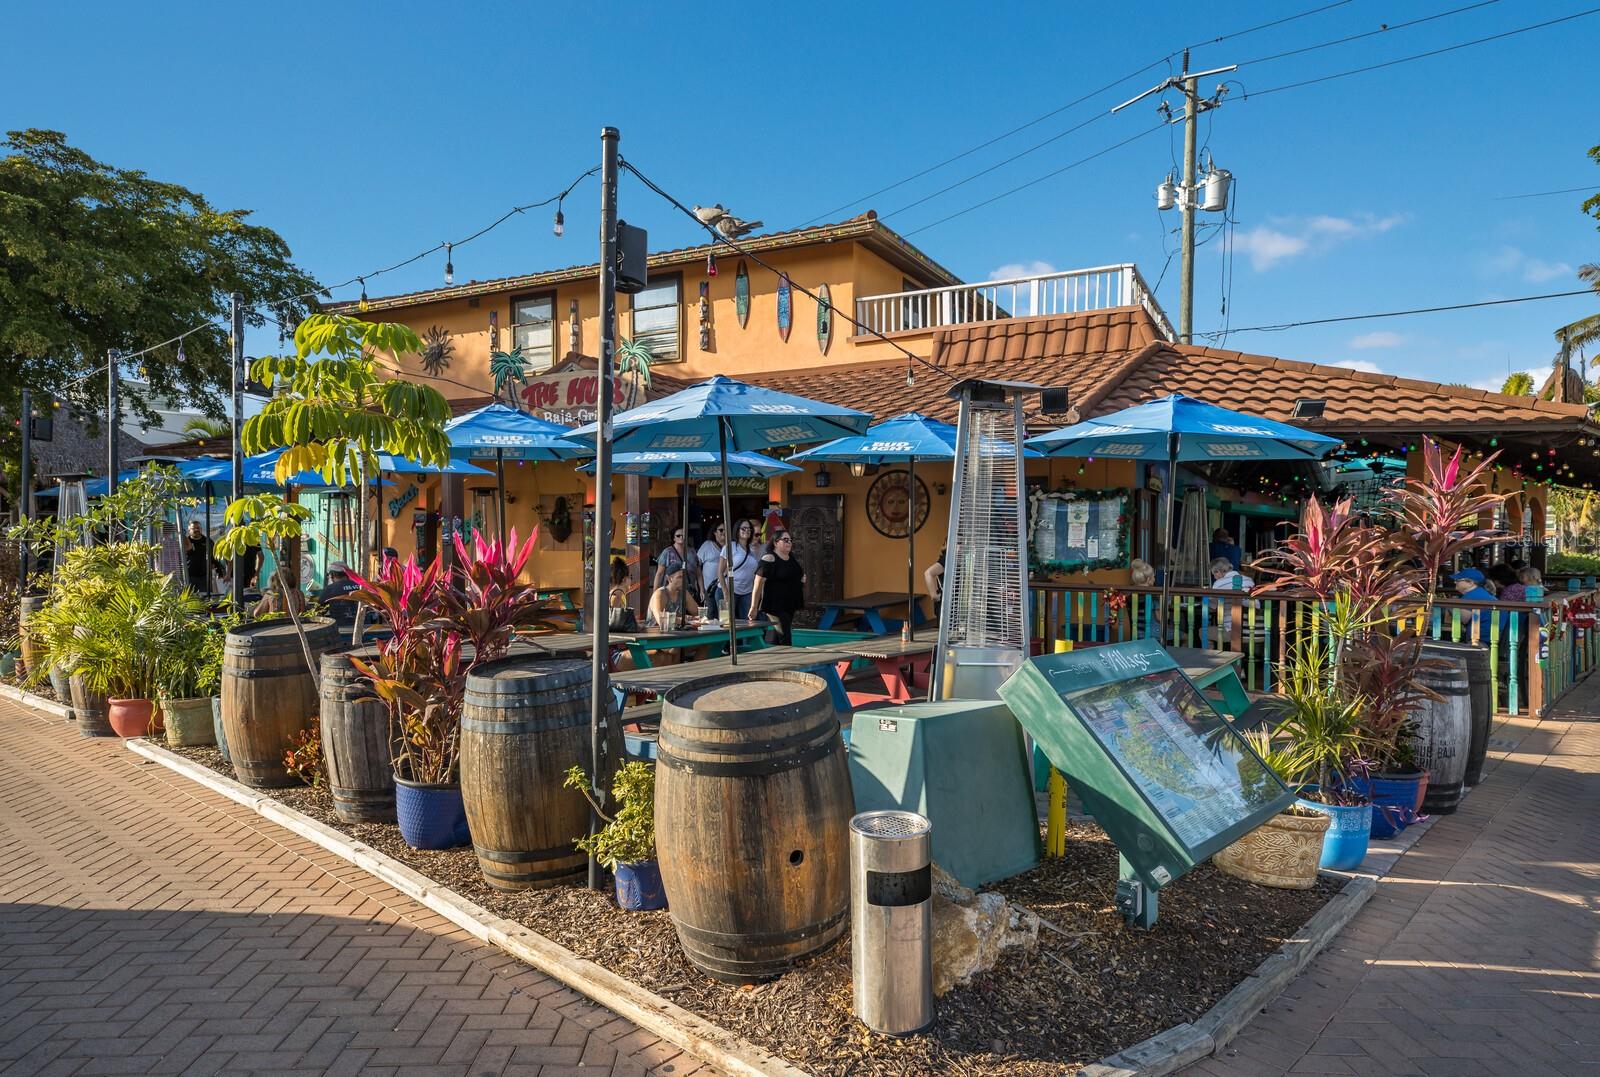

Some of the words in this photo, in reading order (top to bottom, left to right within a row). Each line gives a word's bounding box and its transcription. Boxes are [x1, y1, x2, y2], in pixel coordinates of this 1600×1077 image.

[521, 381, 560, 411] THE
[577, 408, 599, 422] Gri
[767, 425, 802, 436] BUD
[1094, 448, 1145, 456] LIGHT
[699, 477, 767, 490] mararitas
